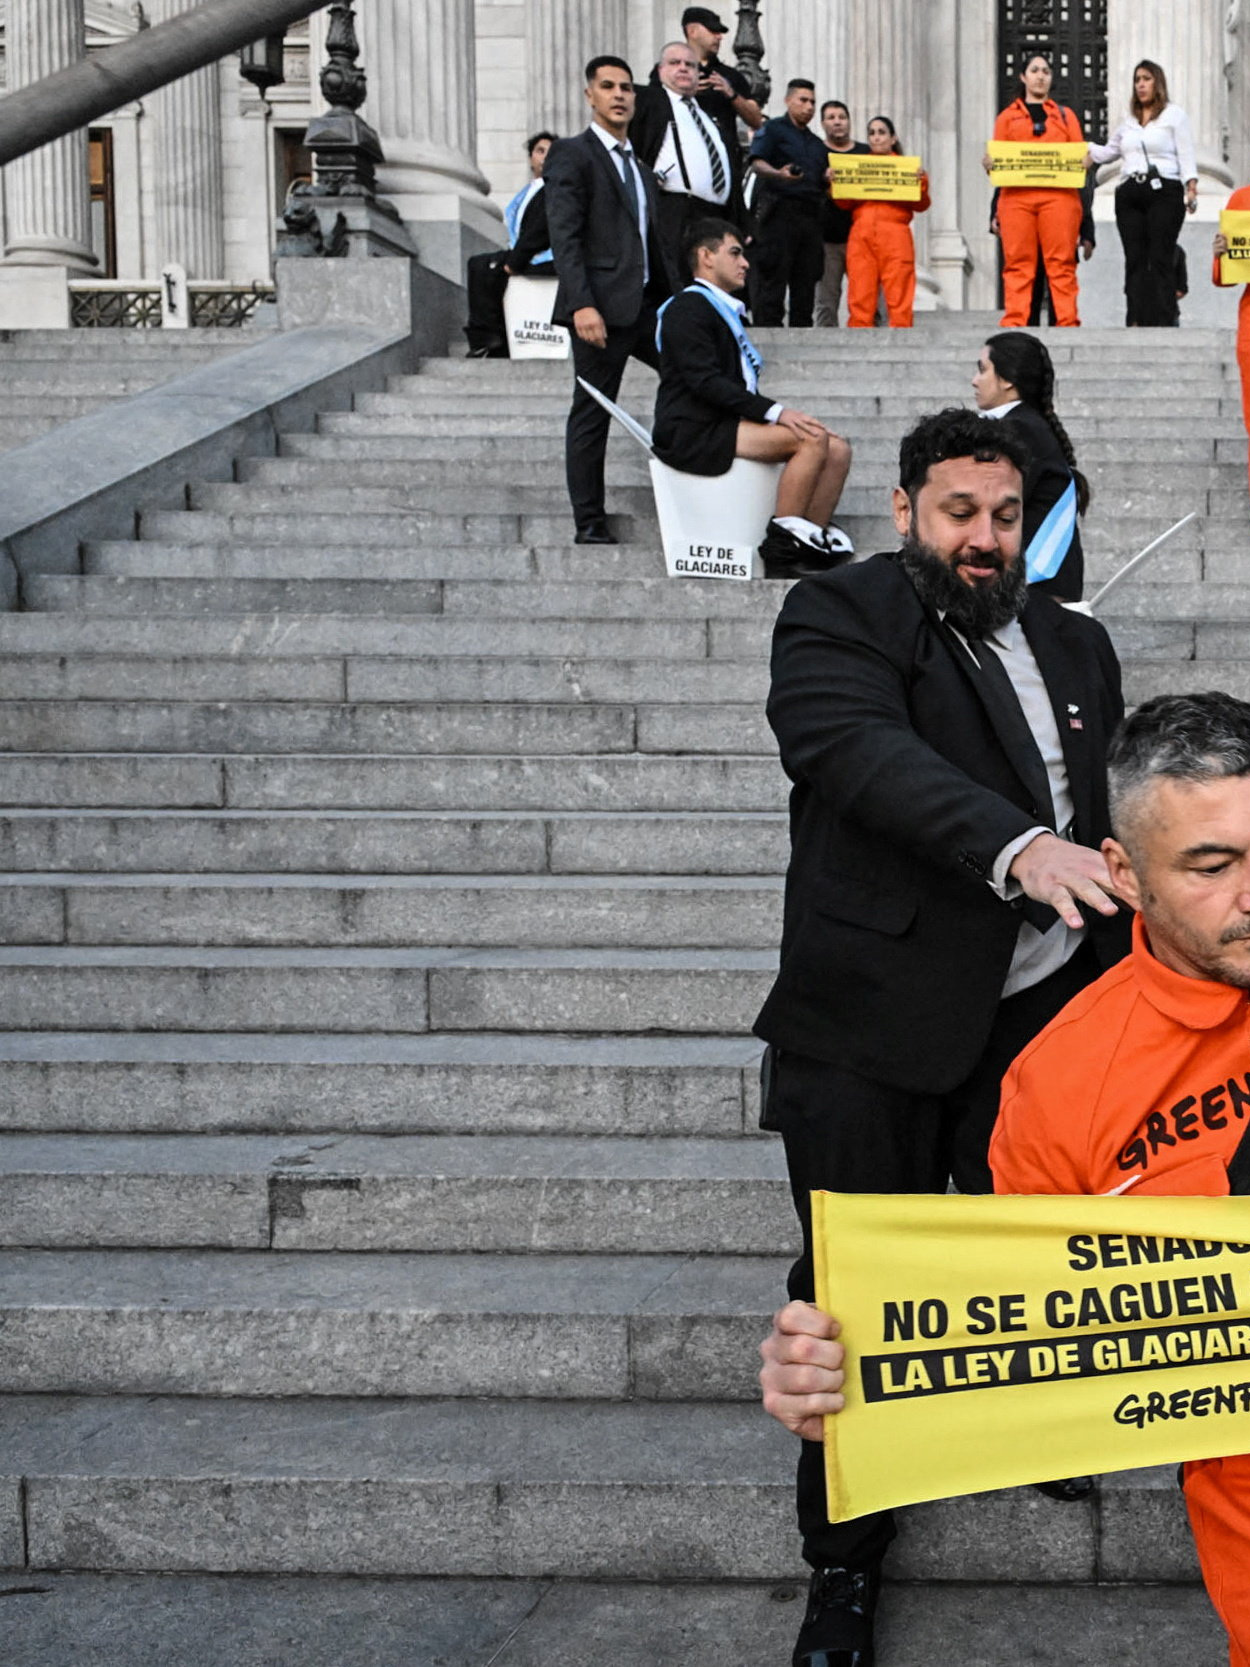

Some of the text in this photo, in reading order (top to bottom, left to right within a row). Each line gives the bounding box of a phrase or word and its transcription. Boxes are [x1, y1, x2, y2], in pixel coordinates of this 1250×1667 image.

[1232, 237, 1247, 246] NO
[689, 545, 734, 560] LEY DE
[675, 559, 747, 576] GLACIARES
[883, 1298, 949, 1342] NO
[966, 1294, 1028, 1335] SE
[1045, 1273, 1238, 1329] CAGUEN
[880, 1359, 933, 1394] LA
[943, 1350, 1015, 1387] LEY
[1028, 1343, 1081, 1378] DE
